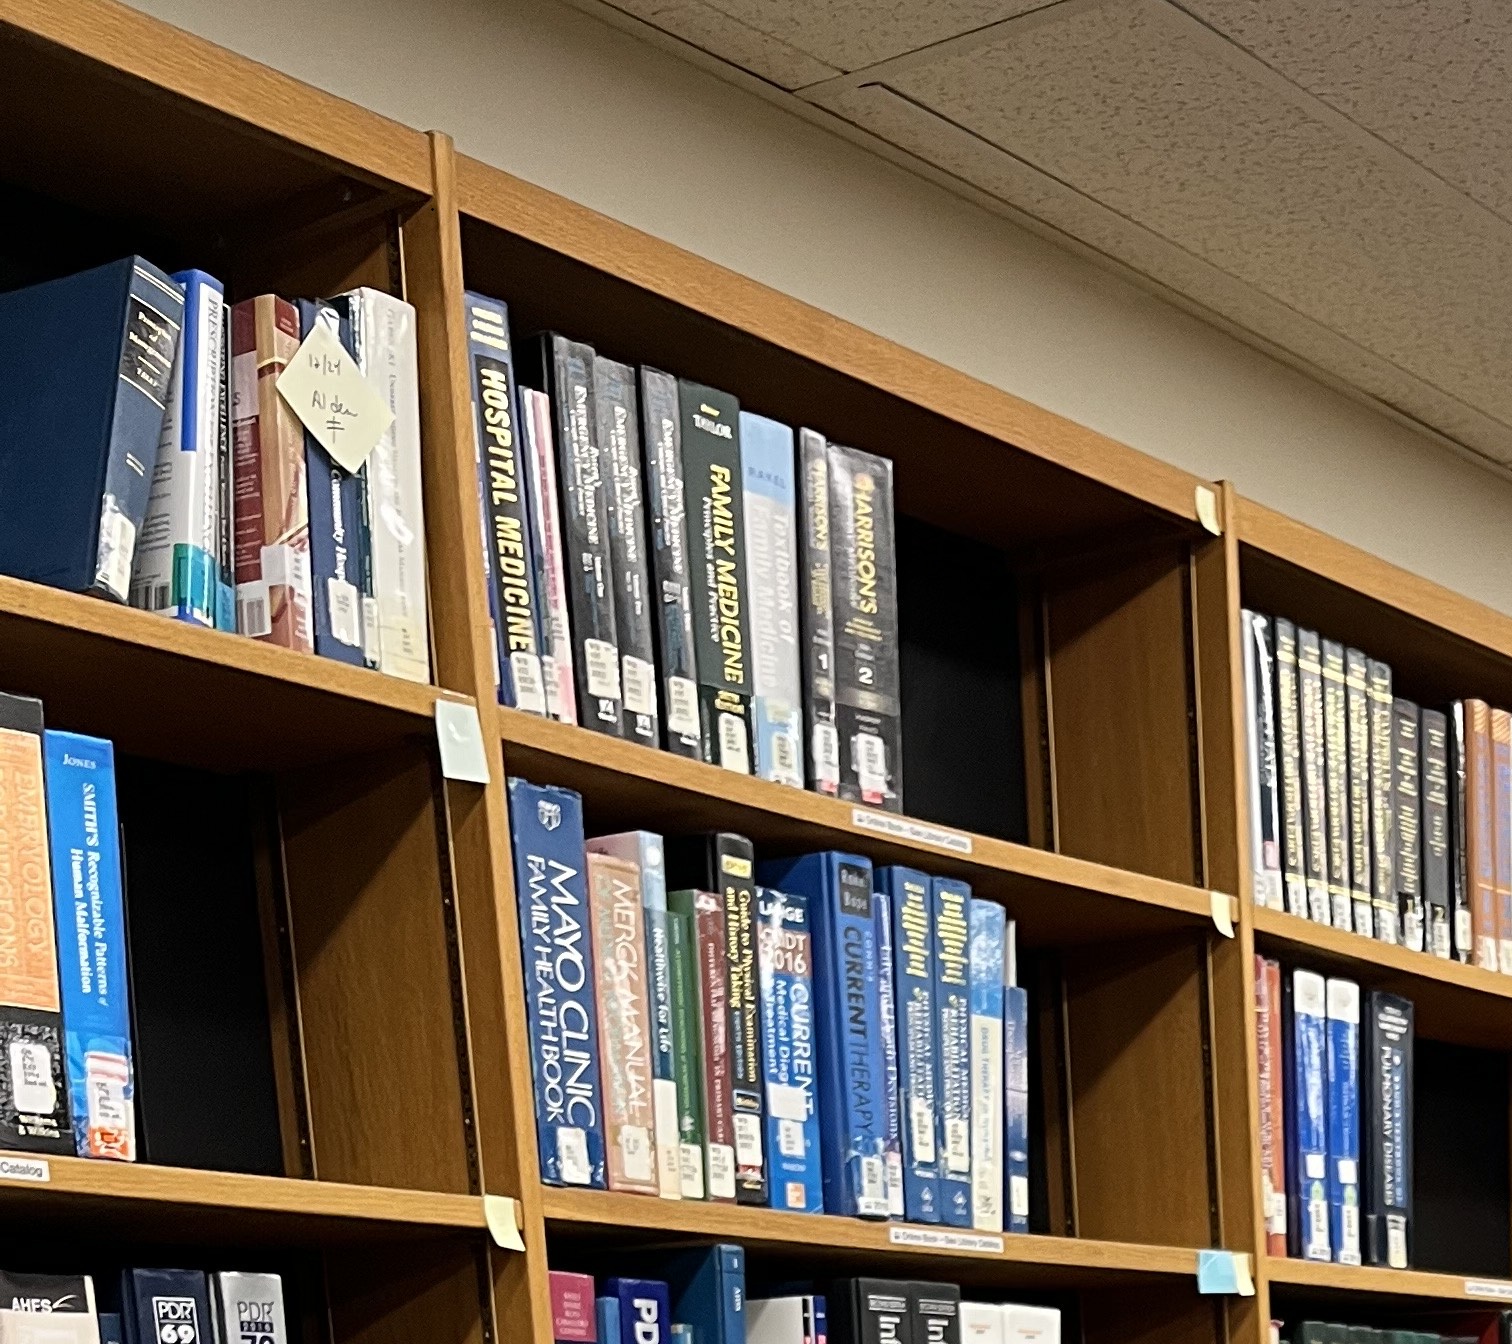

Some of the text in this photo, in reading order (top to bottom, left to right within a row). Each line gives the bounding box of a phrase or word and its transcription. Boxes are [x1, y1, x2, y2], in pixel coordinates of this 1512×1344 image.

[481, 368, 532, 653] HOSPITAL MEDICINE
[768, 512, 793, 602] Textbook
[853, 486, 879, 617] HARRISON'S
[710, 464, 744, 685] FAMILY MEDICINE
[858, 667, 874, 686] 2
[62, 752, 97, 770] JONES
[70, 847, 92, 994] Human Malformation
[82, 782, 108, 992] SMITH'S Recognizable Patterns
[612, 878, 638, 982] MERCK
[738, 890, 751, 926] Guide
[527, 854, 565, 1122] FAMILY HEALTH BOOK
[547, 858, 596, 1128] MAYO CLINIC
[651, 928, 669, 1054] Healthwise for Life
[725, 886, 741, 1008] and History Taking
[740, 948, 755, 1000] Physical
[742, 1003, 755, 1083] Examination
[775, 980, 789, 1043] Medical
[844, 926, 874, 1133] CURRENT THERAPY
[1, 1161, 43, 1178] Catalog
[1381, 1045, 1396, 1206] PULMONARY DISEASES
[11, 1297, 53, 1313] AHFS
[158, 1301, 193, 1321] PDR
[160, 1323, 194, 1344] 69
[237, 1300, 274, 1323] PDR
